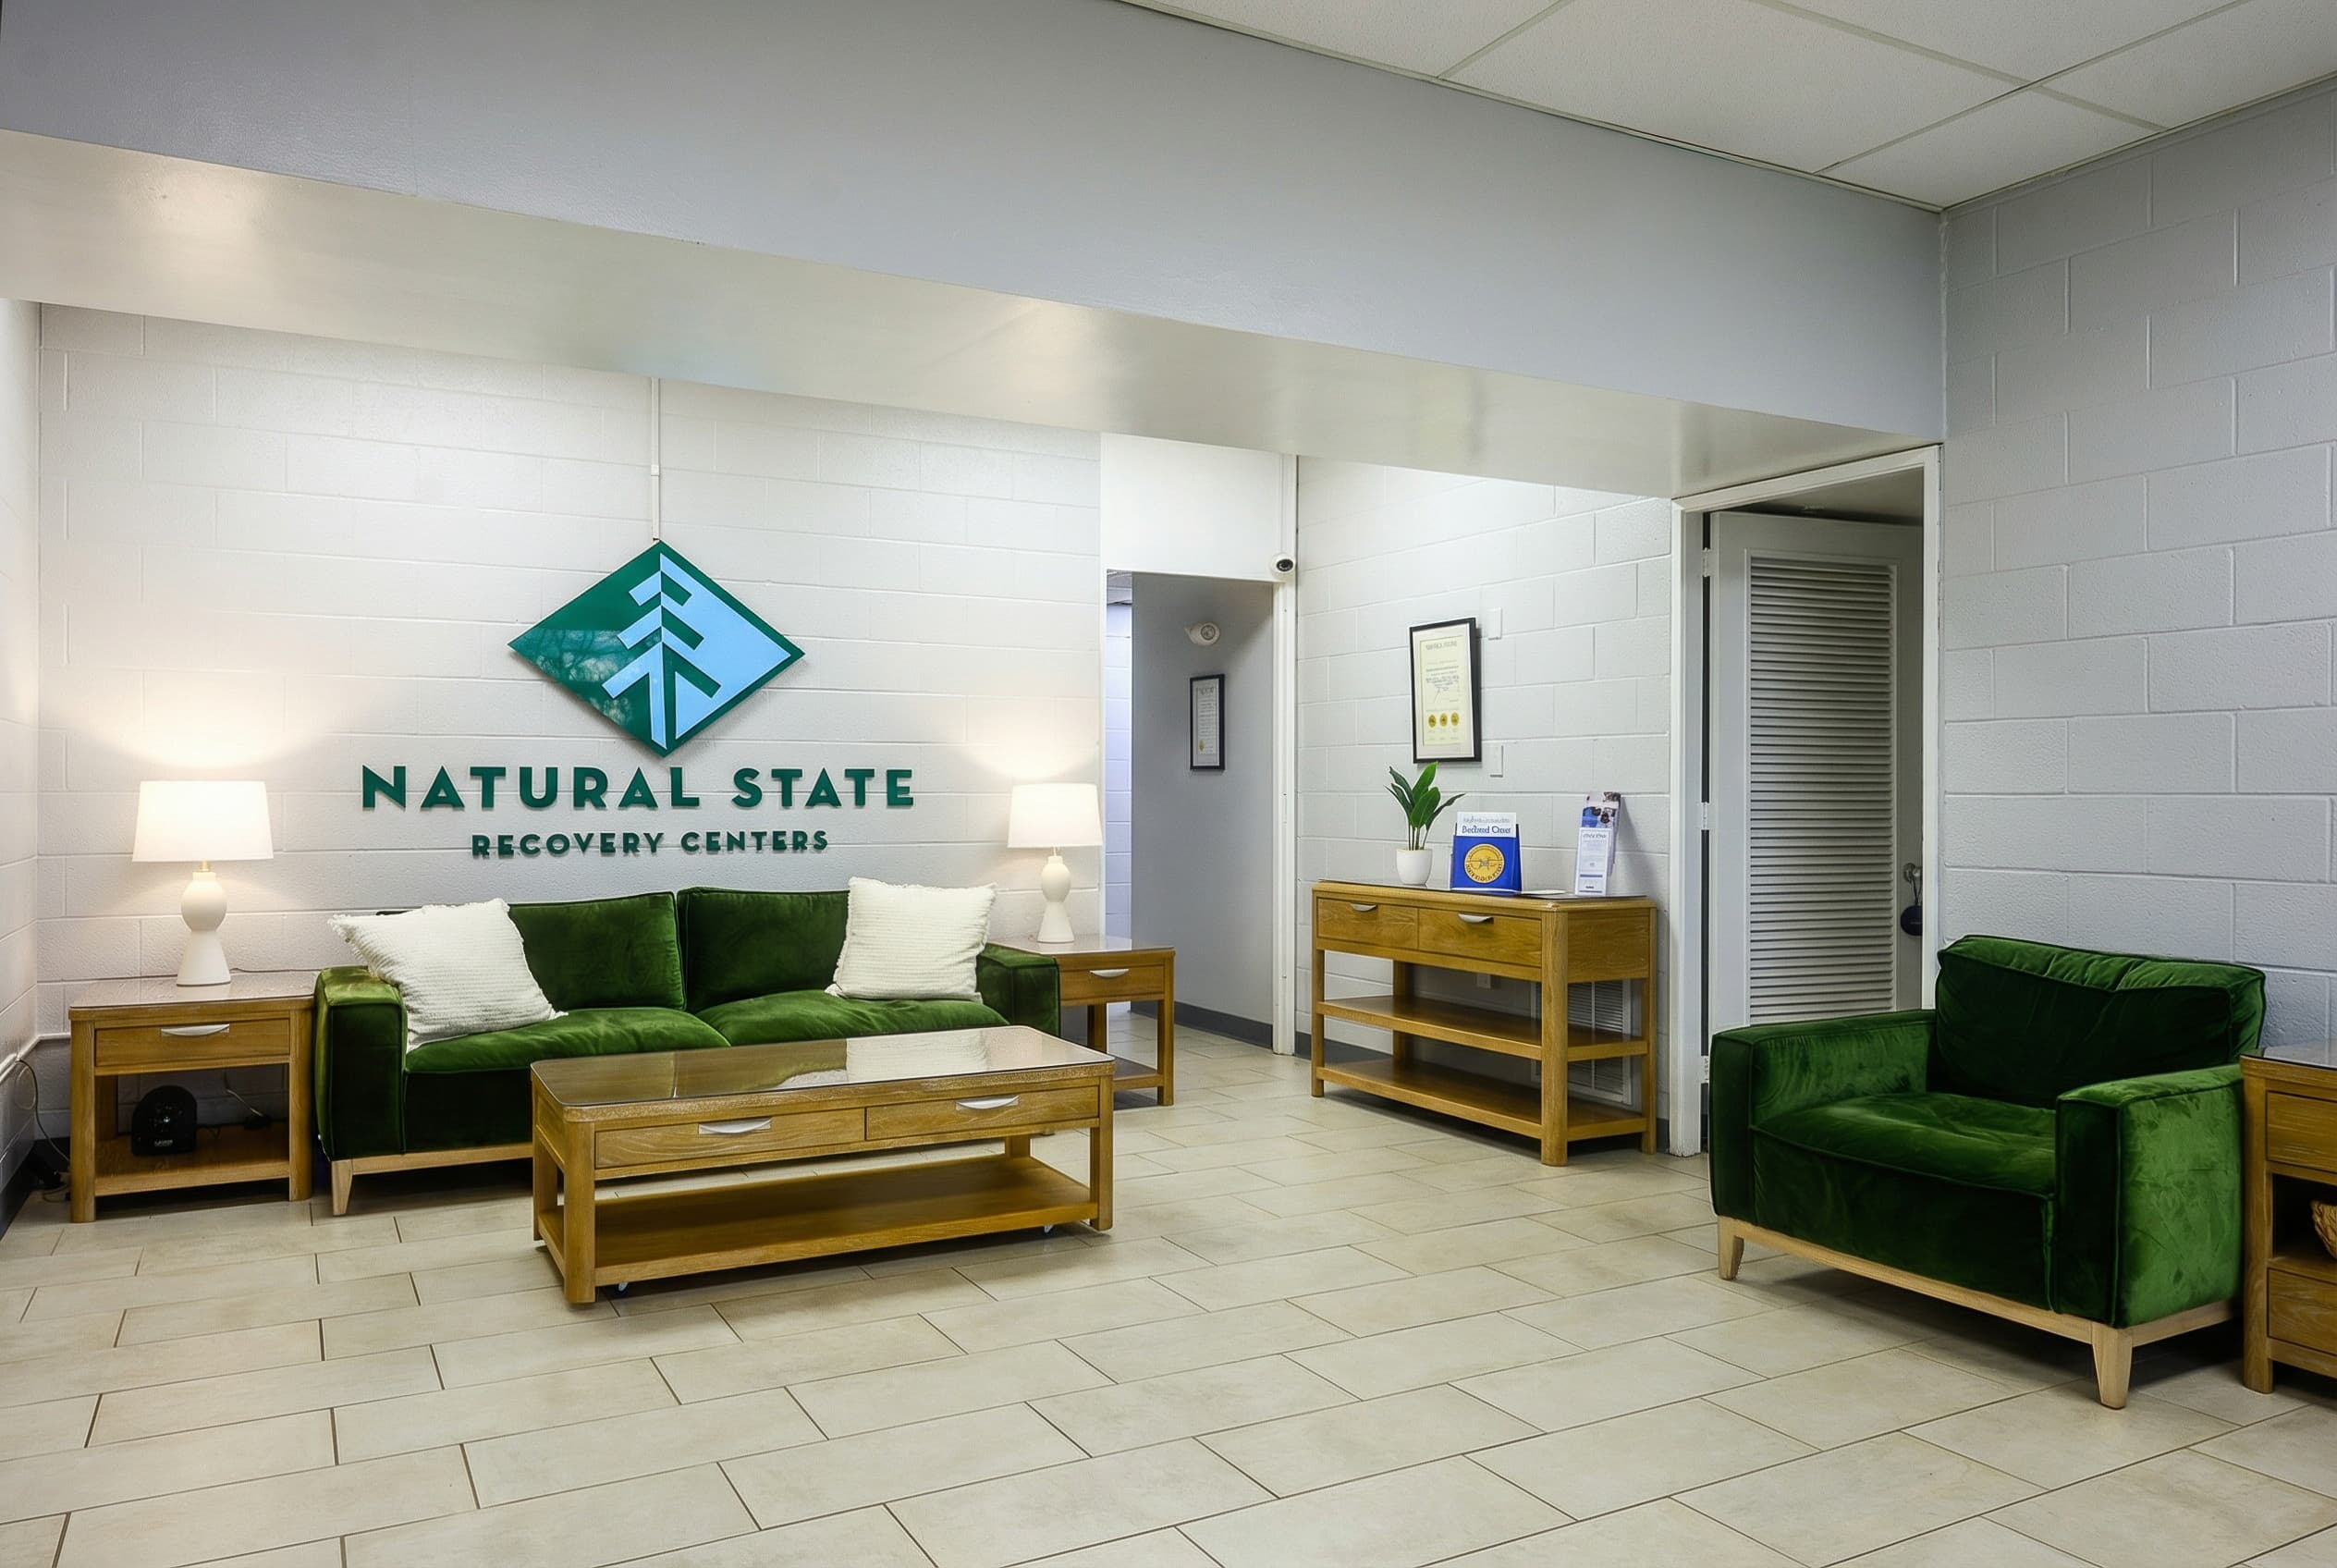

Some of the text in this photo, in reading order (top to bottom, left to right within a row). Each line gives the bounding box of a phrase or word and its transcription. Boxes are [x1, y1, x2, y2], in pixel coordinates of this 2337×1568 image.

[362, 766, 913, 810] NATURAL STATE
[472, 830, 827, 856] RECOVERY CENTERS
